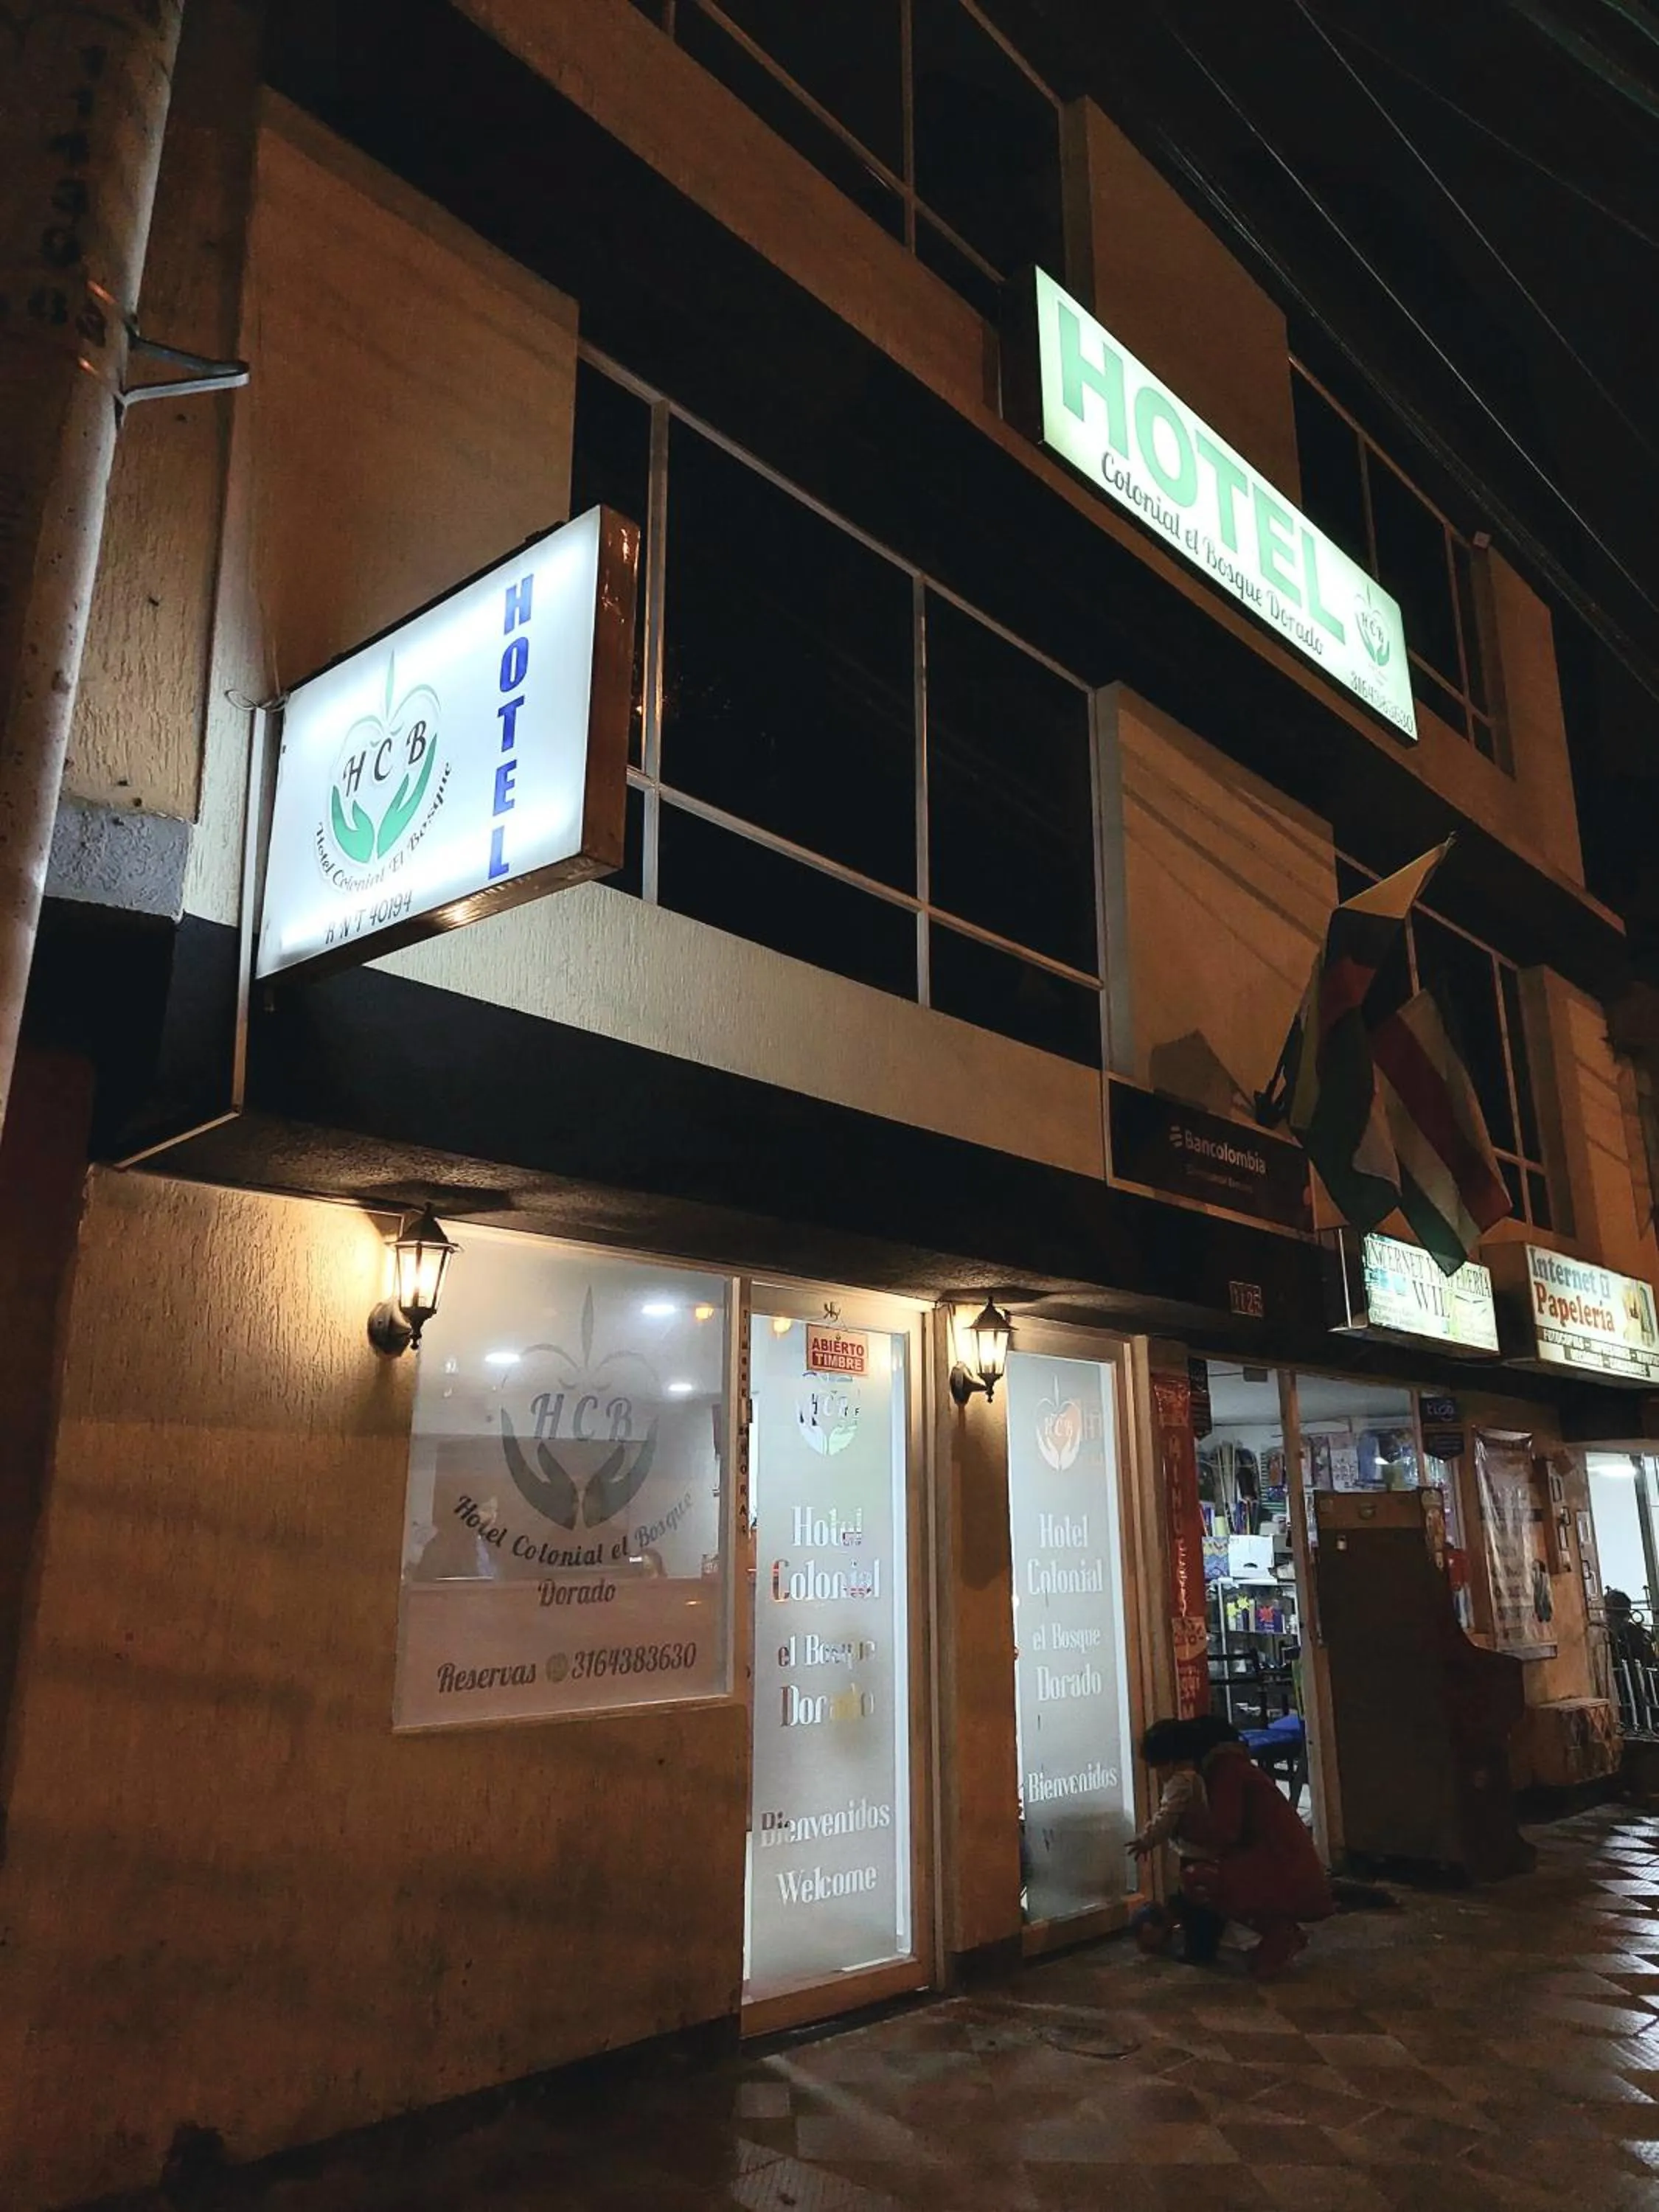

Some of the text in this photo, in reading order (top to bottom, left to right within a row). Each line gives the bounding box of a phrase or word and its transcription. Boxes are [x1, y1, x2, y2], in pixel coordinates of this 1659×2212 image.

[1058, 300, 1346, 647] HOTEL
[1101, 451, 1324, 657] Colonial el Bosque Dorado
[488, 573, 534, 881] HOTEL
[315, 821, 335, 875] Hotel
[389, 851, 404, 873] El
[407, 762, 453, 852] Bosque
[369, 889, 413, 927] 40194
[1183, 1129, 1267, 1176] Bancolombia
[1528, 1248, 1598, 1295] Internet
[812, 1337, 865, 1357] ABIERTO
[815, 1353, 863, 1371] TIMBRE
[530, 1393, 633, 1443] HCB
[453, 1492, 693, 1568] Hotel Colonial el Bosque
[1038, 1513, 1089, 1548] Hotel
[537, 1578, 616, 1607] Dorado
[1027, 1558, 1103, 1597] Colonial
[778, 1635, 796, 1668] el
[1032, 1621, 1102, 1654] el Bosque
[437, 1641, 697, 1695] Reservas 3164383630
[1037, 1663, 1102, 1702] Dorado
[1027, 1761, 1119, 1804] Bienvenidos
[760, 1799, 891, 1848] Bienvenidos
[776, 1864, 877, 1905] Welcome
